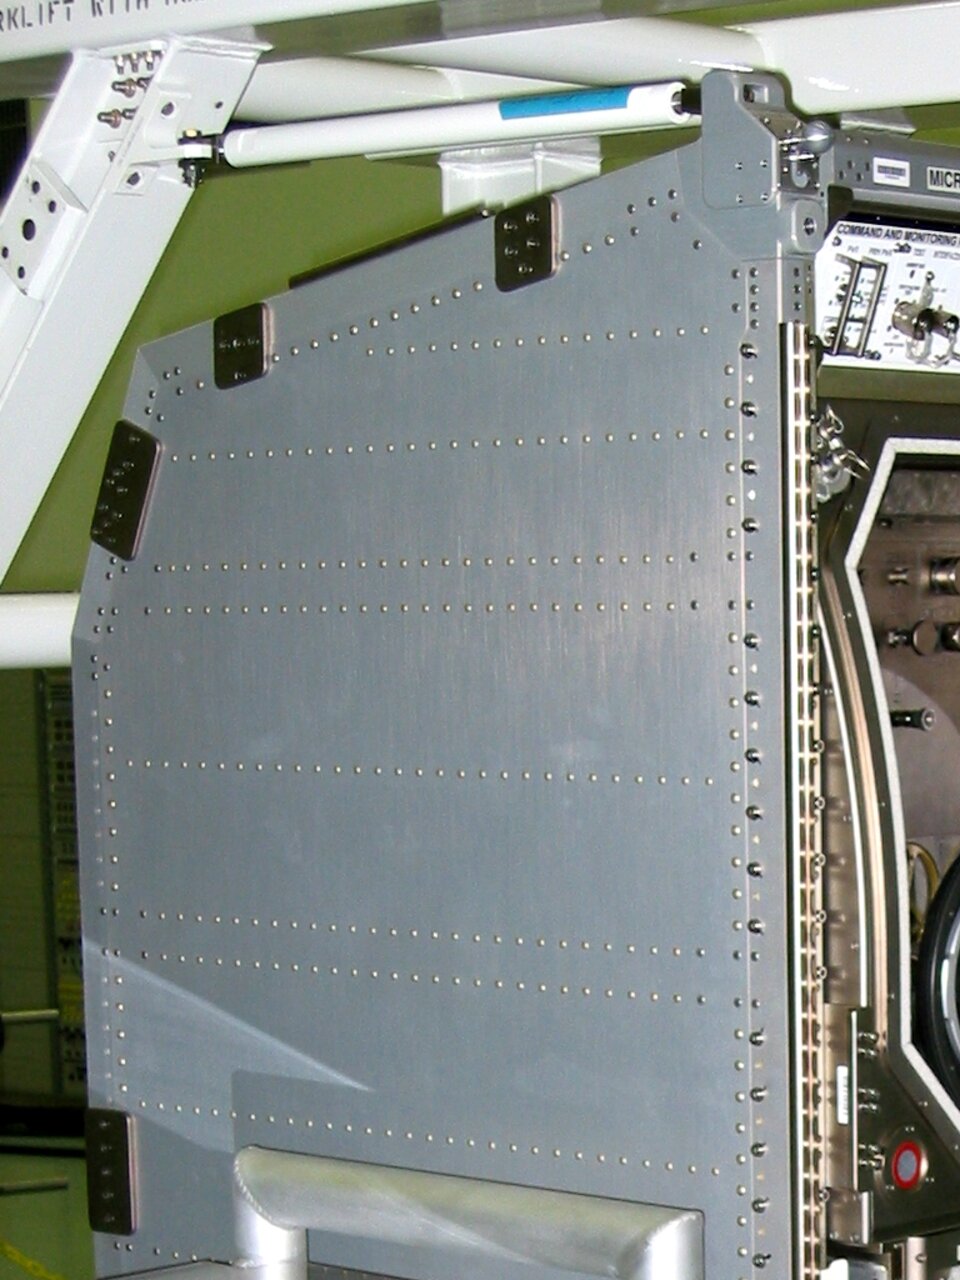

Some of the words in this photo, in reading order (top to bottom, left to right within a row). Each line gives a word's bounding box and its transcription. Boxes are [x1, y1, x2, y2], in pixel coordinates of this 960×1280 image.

[837, 223, 883, 239] COMMAND
[884, 228, 904, 241] AND
[904, 230, 957, 247] MONITORING
